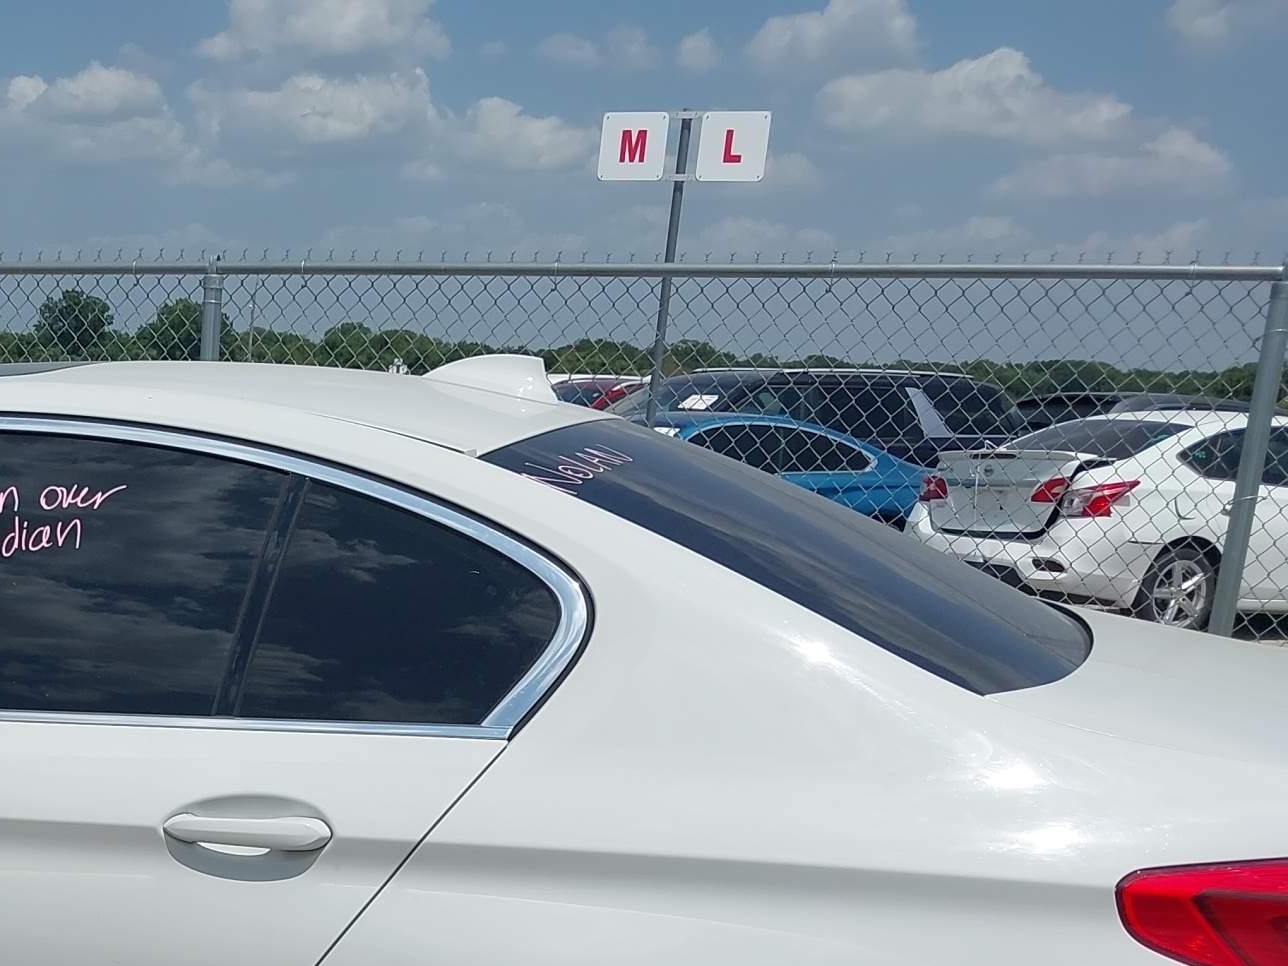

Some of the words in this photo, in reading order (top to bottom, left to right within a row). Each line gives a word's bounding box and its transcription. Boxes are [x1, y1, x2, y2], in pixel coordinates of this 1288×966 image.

[618, 129, 648, 163] M
[722, 129, 742, 163] L
[40, 484, 128, 511] over
